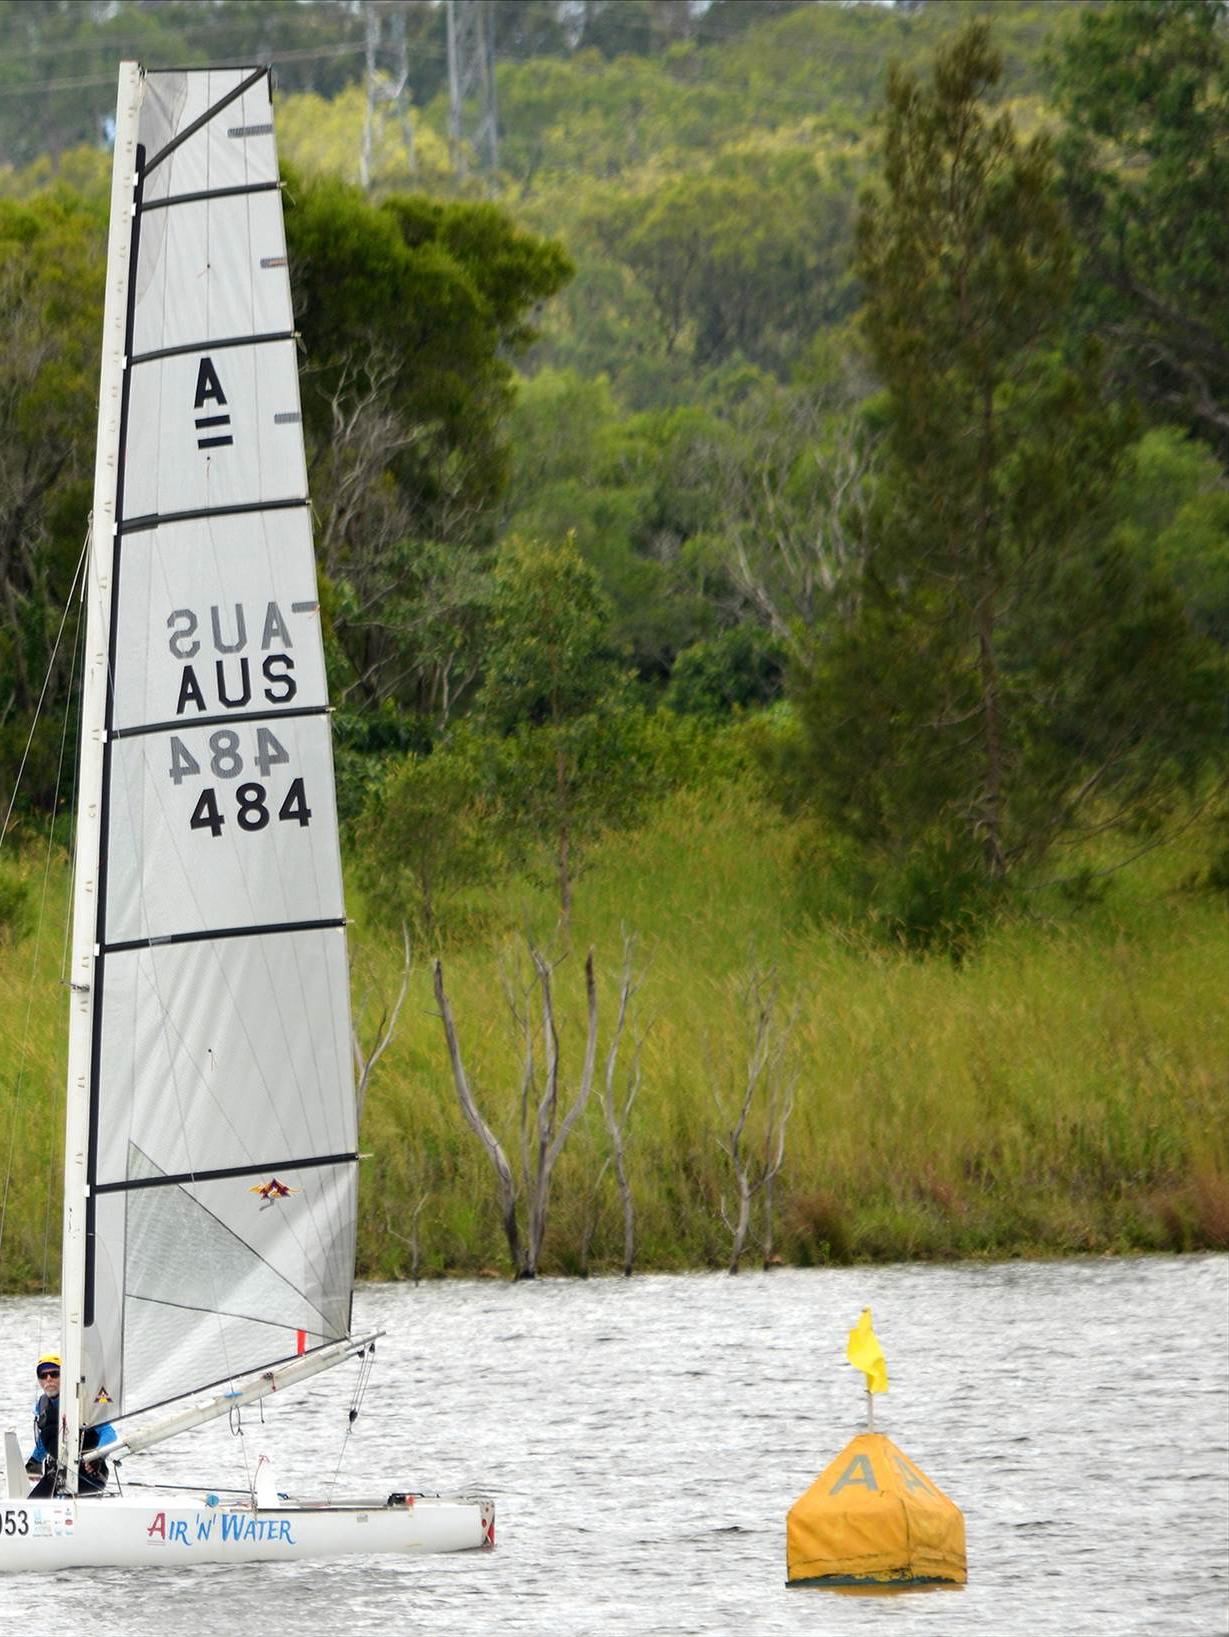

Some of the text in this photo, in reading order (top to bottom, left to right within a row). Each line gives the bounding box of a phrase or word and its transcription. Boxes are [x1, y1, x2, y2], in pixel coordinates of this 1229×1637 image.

[194, 357, 228, 409] A
[176, 654, 298, 714] AUS
[190, 777, 312, 838] 484
[828, 1454, 878, 1496] A
[892, 1455, 935, 1497] A
